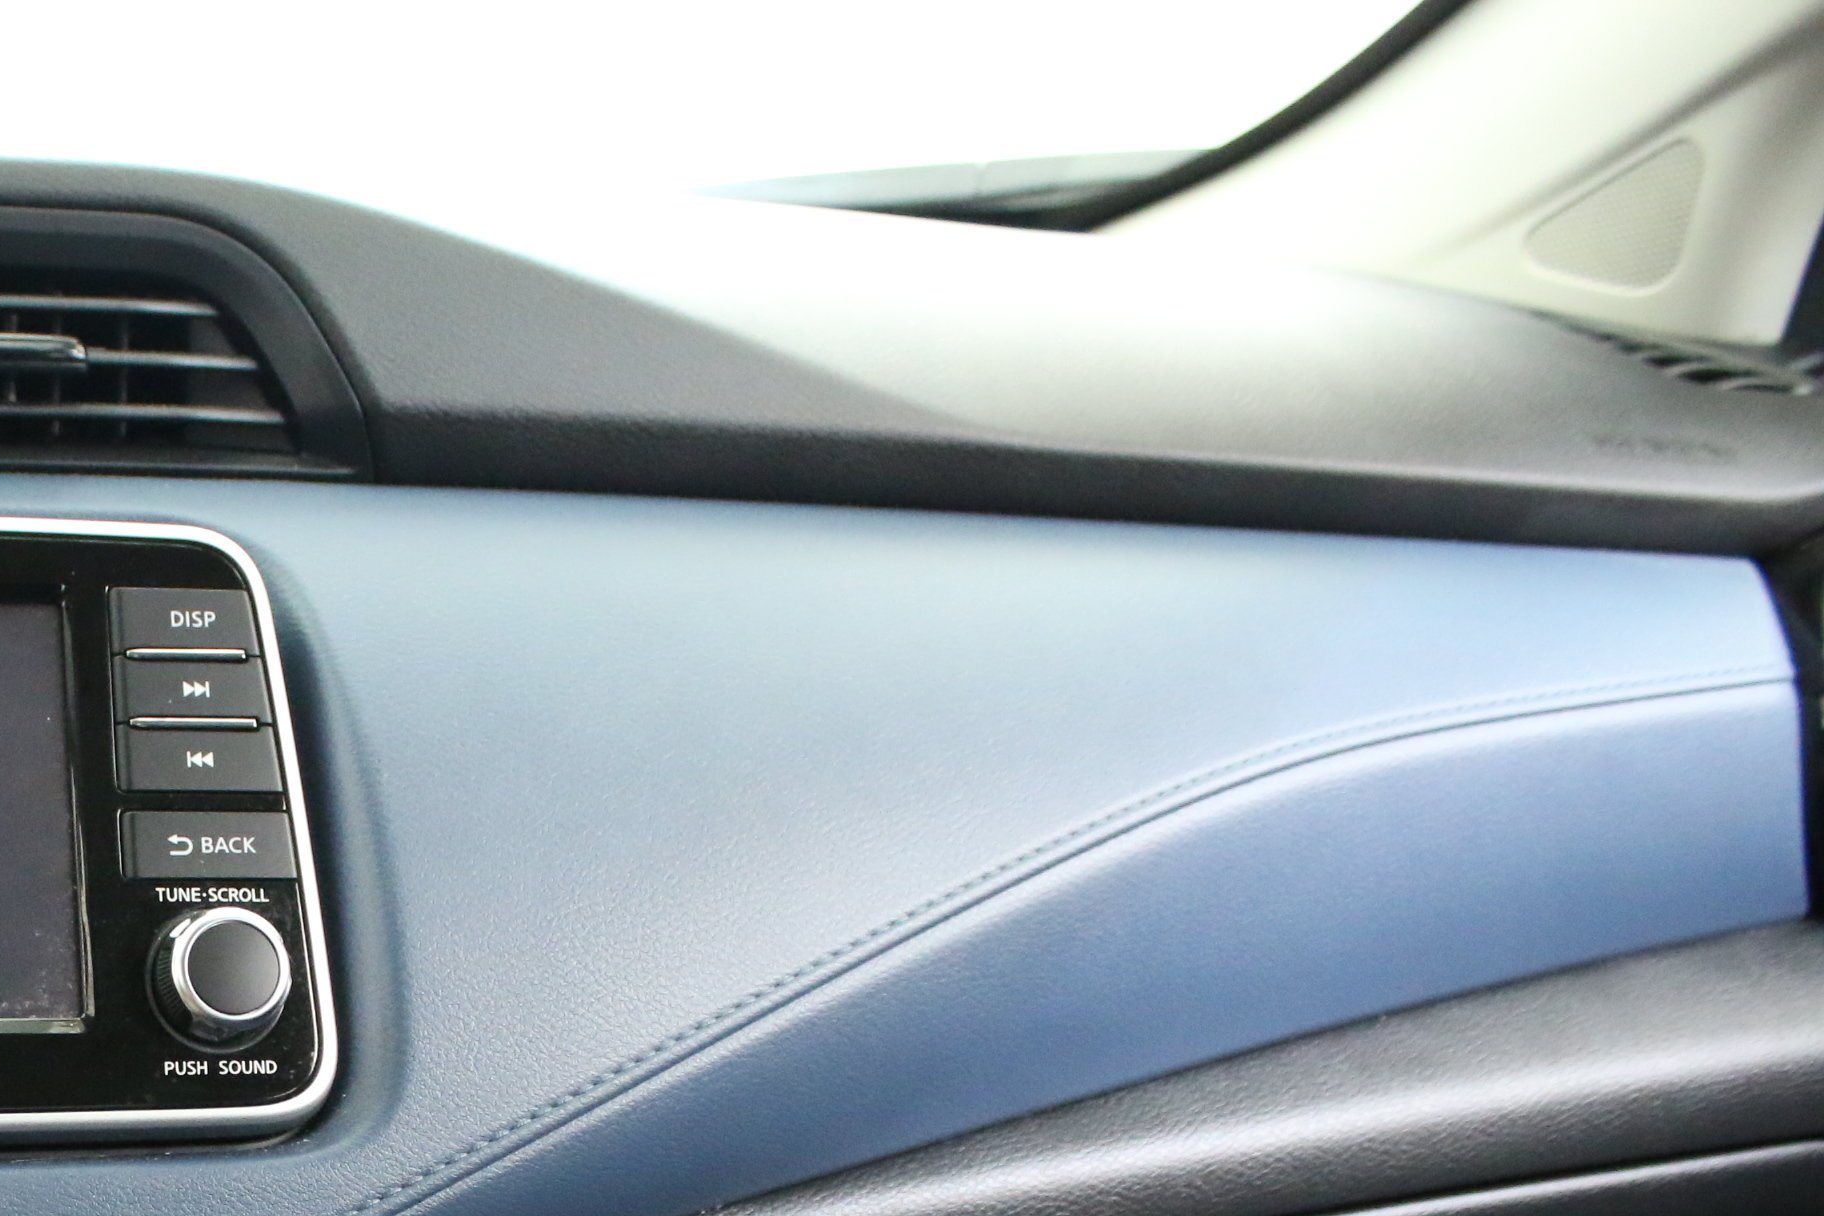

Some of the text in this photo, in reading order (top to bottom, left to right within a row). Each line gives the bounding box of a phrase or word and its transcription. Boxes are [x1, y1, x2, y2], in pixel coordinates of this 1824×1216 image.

[169, 610, 217, 629] DISP
[200, 836, 257, 855] BACK
[163, 1059, 278, 1076] PUSH SOUND
